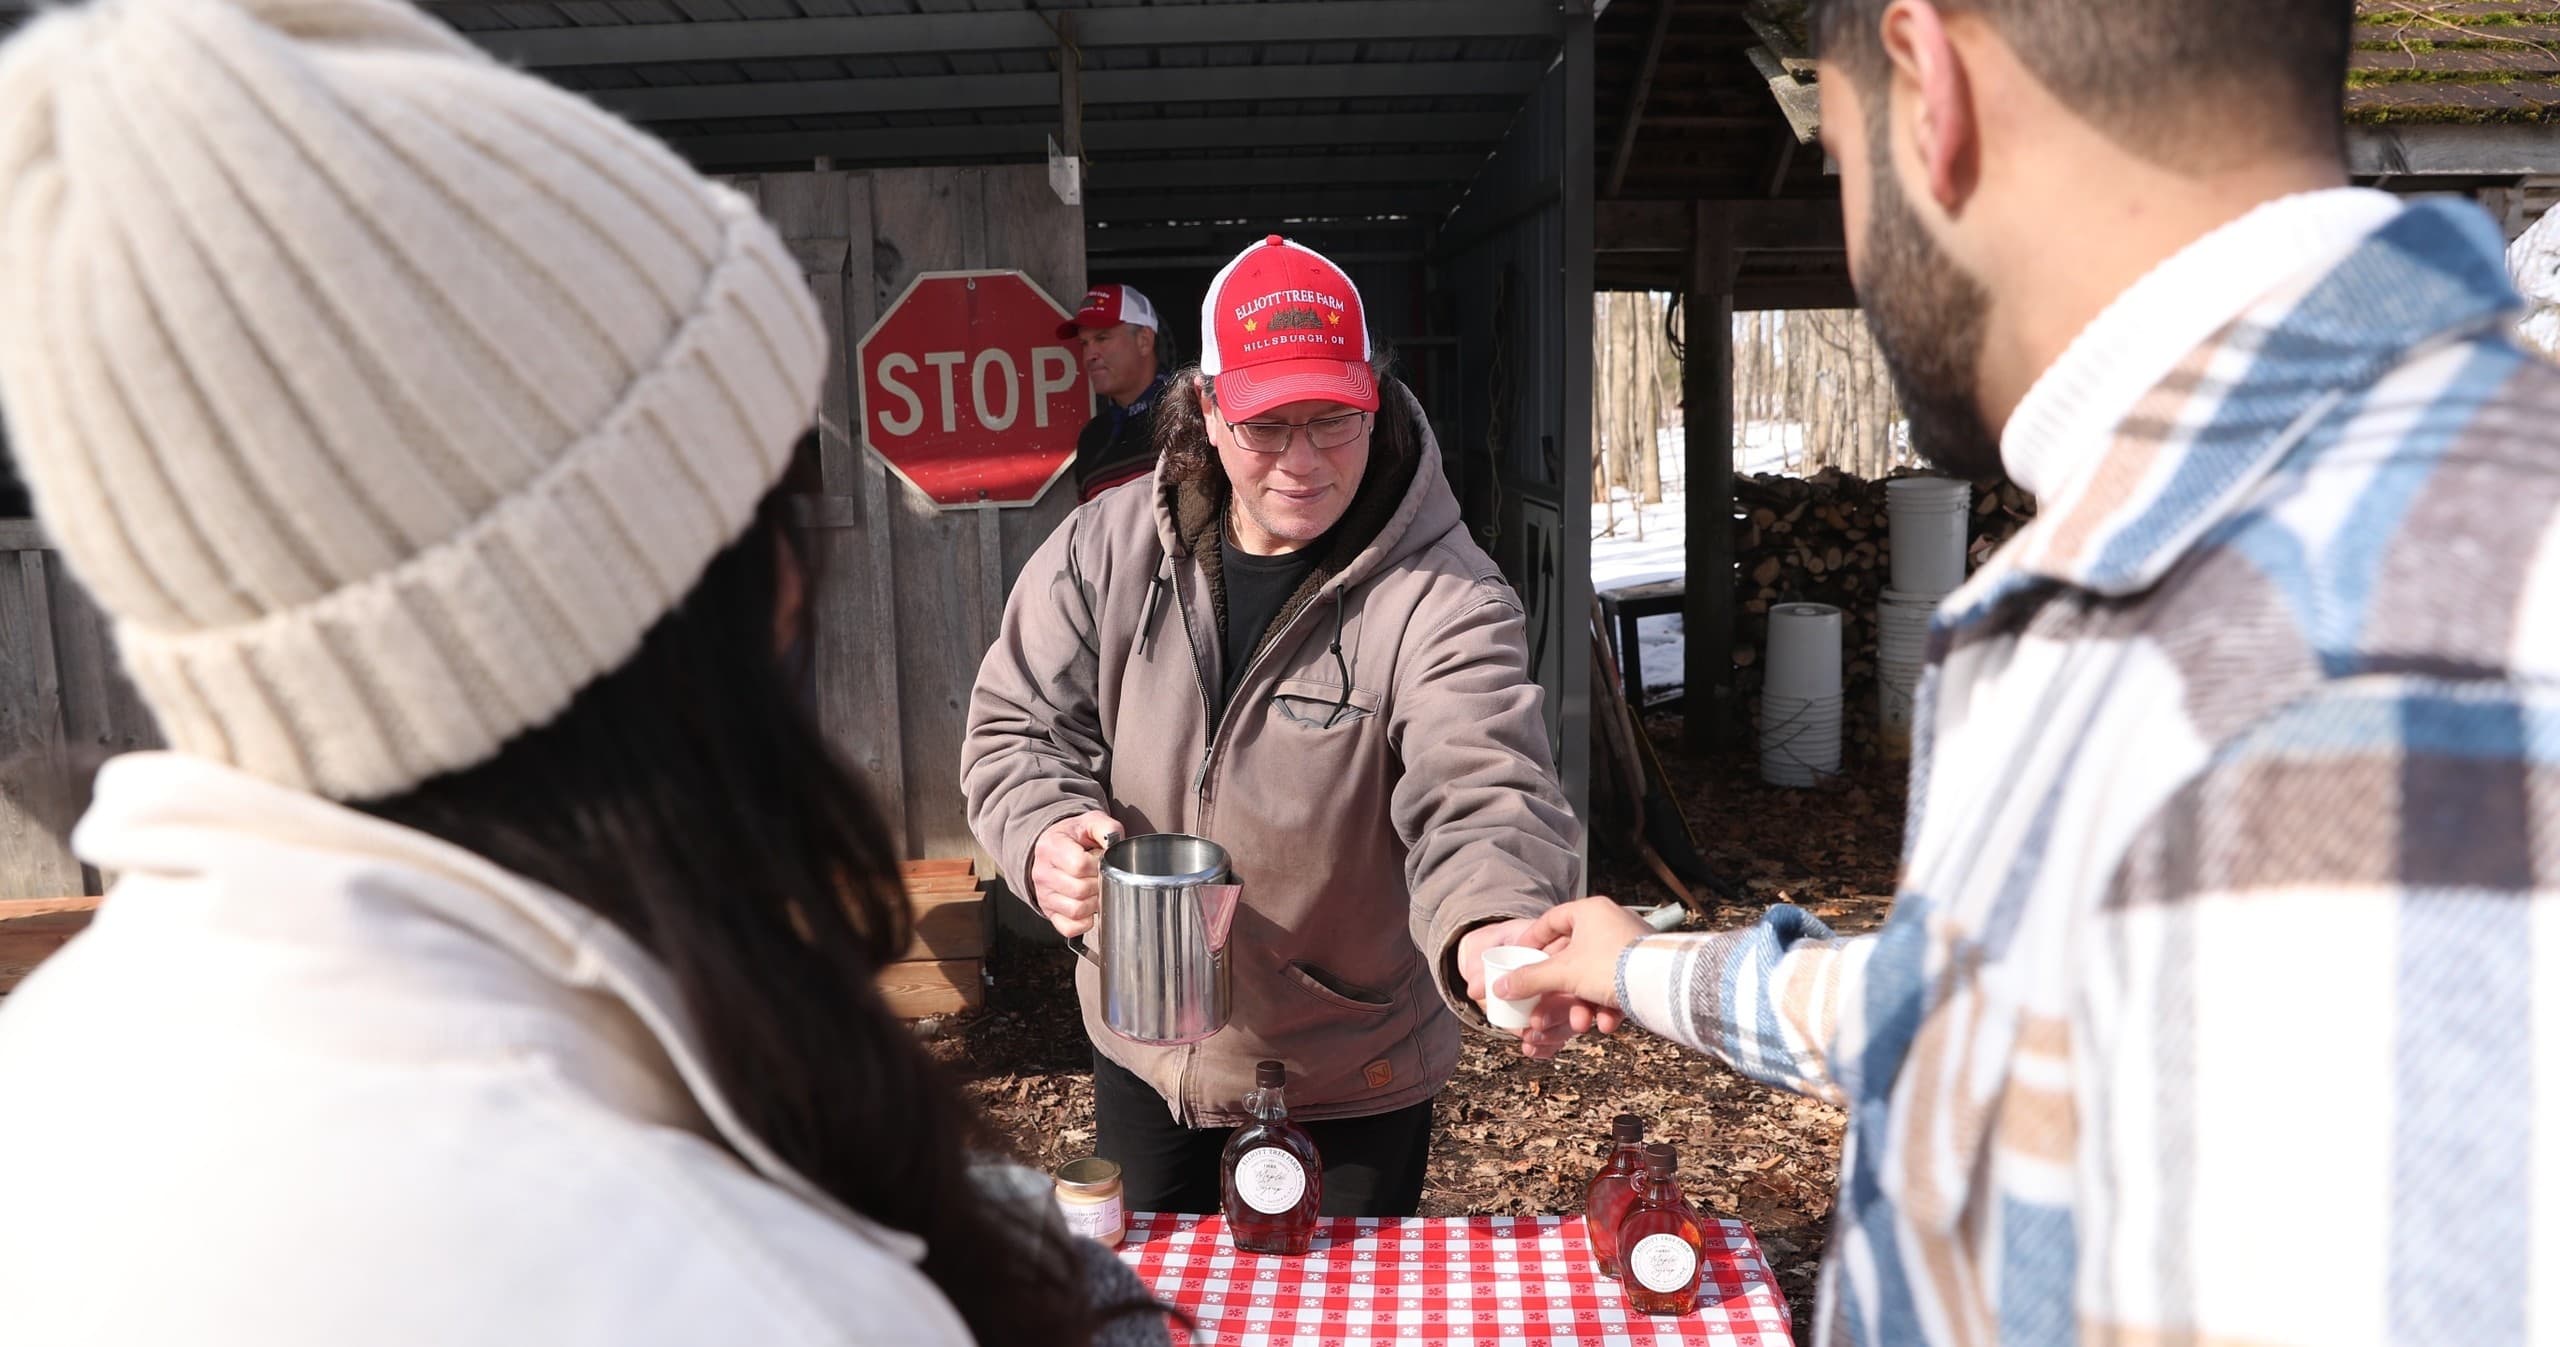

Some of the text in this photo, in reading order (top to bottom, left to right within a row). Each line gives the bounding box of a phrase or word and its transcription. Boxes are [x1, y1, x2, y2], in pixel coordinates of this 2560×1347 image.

[1235, 290, 1344, 320] ELLIOTT TREE FARM
[1244, 334, 1345, 352] HILLSBURGH, ON
[877, 346, 1077, 437] STOP
